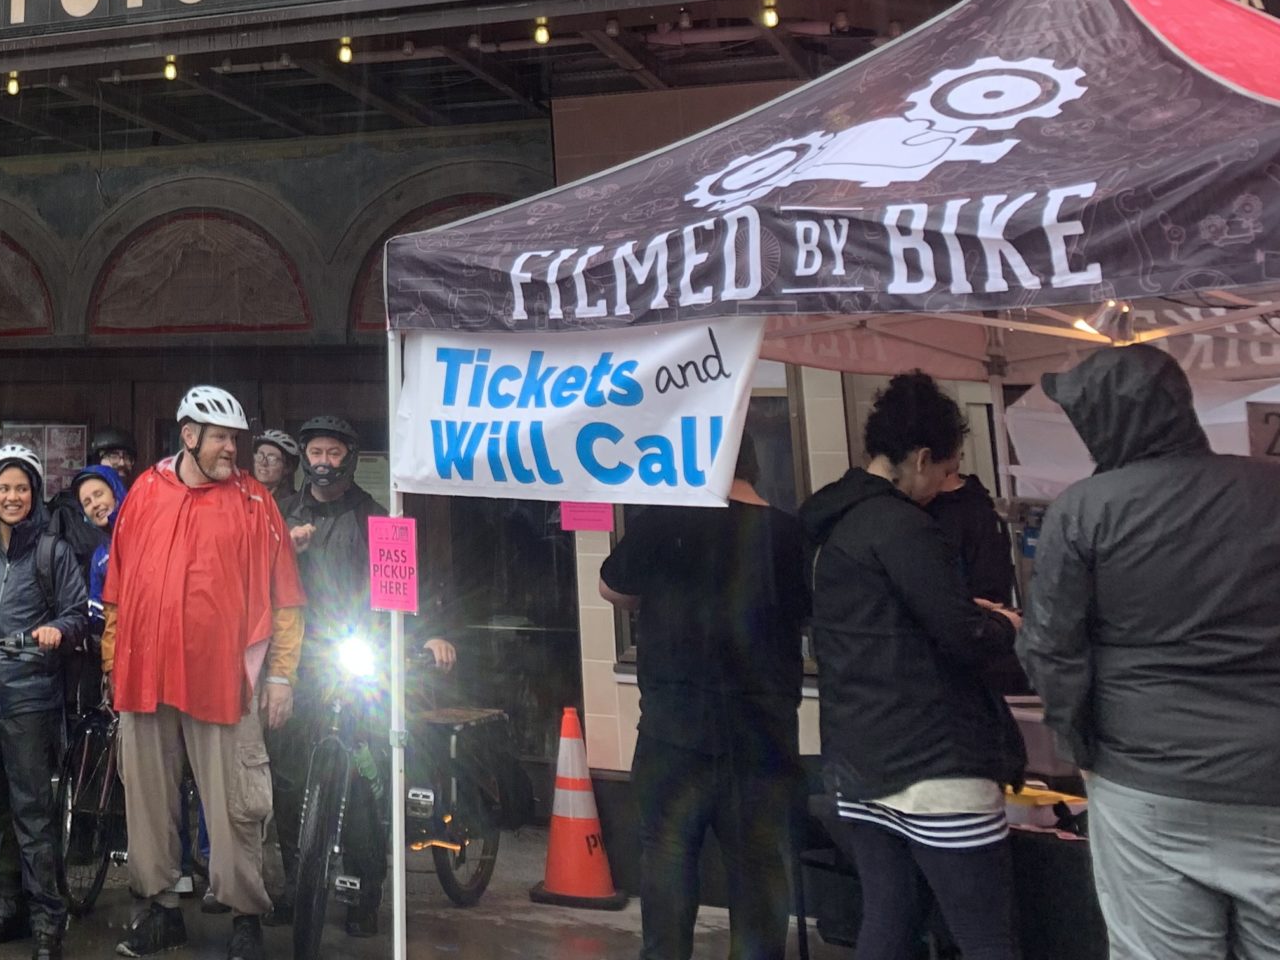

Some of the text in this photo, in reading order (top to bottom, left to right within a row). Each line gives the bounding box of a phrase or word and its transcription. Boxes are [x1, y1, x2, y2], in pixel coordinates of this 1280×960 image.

[510, 182, 1103, 320] FILMED BY BIKE
[436, 347, 644, 409] Tickets
[655, 327, 732, 394] and
[430, 419, 564, 485] Will
[576, 416, 723, 487] Call
[372, 563, 415, 580] PICKUP
[378, 548, 407, 563] PASS
[380, 581, 408, 596] HERE
